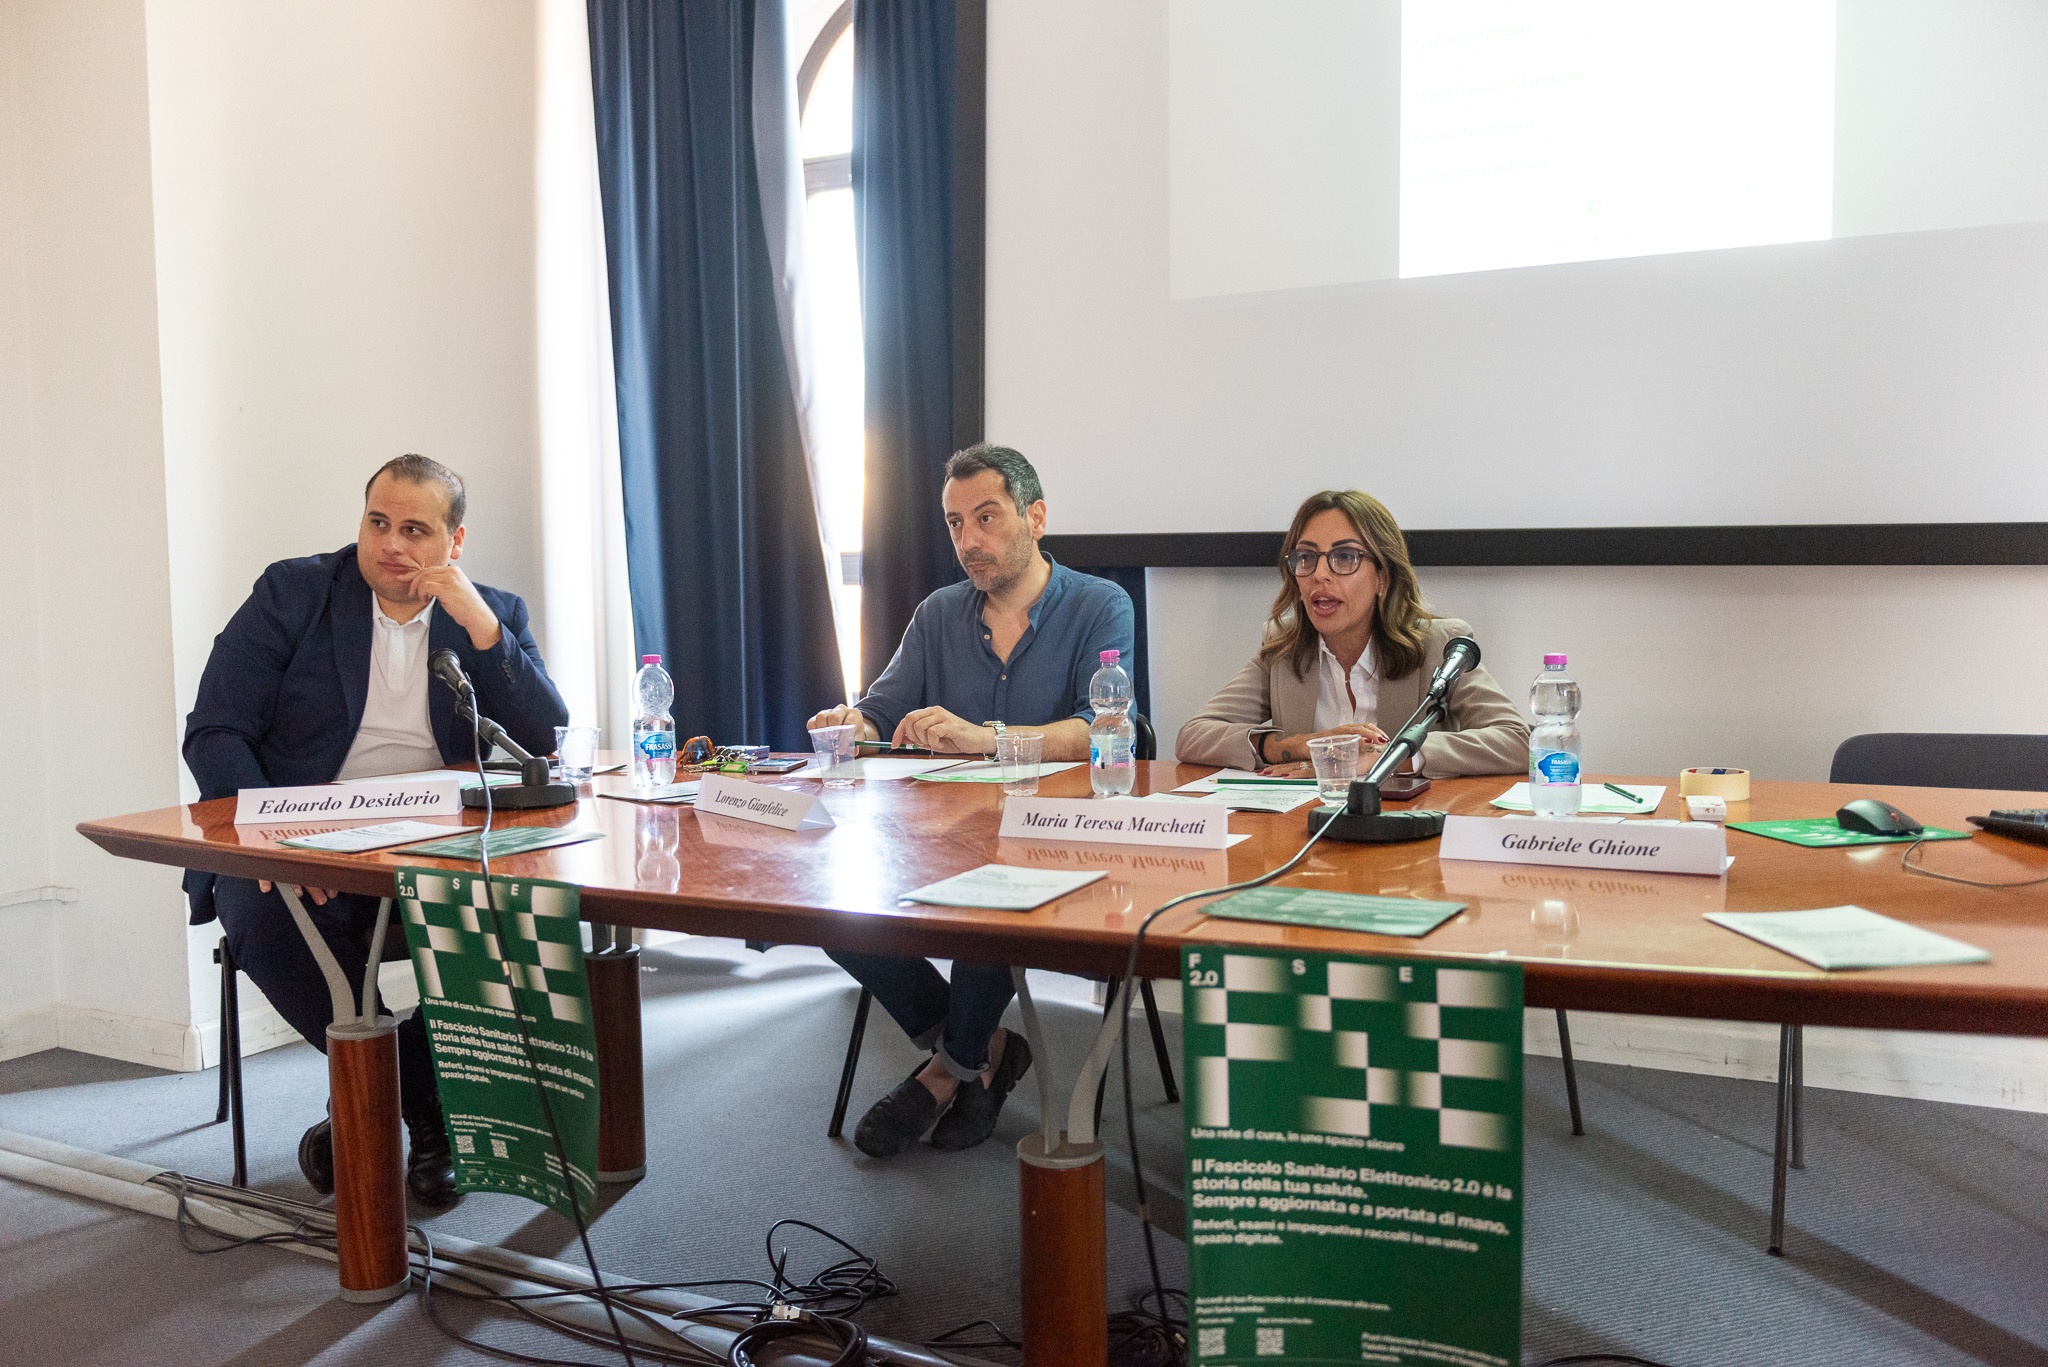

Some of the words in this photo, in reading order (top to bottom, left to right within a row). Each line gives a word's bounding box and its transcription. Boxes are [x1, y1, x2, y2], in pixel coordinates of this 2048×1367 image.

[258, 797, 342, 814] Edoardo
[348, 790, 440, 809] Desiderio
[716, 790, 747, 808] Lorenzo
[748, 798, 789, 818] Gianfelice
[1022, 812, 1068, 828] Maria
[1074, 814, 1124, 831] Teresa
[1128, 816, 1206, 835] Marchetti
[1501, 834, 1582, 853] Gabriele
[1588, 838, 1660, 857] Ghione
[398, 872, 404, 883] F
[452, 878, 460, 890] S
[510, 884, 519, 896] E
[400, 886, 414, 897] 2.0
[1188, 954, 1200, 968] F
[1292, 960, 1306, 974] S
[1400, 966, 1412, 982] E
[1190, 970, 1218, 986] 2.0
[430, 1019, 436, 1028] Il
[437, 1020, 478, 1034] Fascicolo
[479, 1026, 517, 1042] Sanitario
[518, 1034, 566, 1052] Ettronico
[566, 1044, 580, 1056] 2.0
[586, 1050, 594, 1062] la
[432, 1032, 460, 1042] storia
[460, 1035, 481, 1046] della
[482, 1039, 496, 1050] tua
[497, 1043, 526, 1056] salute.
[434, 1043, 472, 1056] Sempre
[472, 1050, 518, 1065] aggiornata
[526, 1060, 532, 1068] a
[534, 1062, 563, 1076] ortata
[564, 1068, 572, 1078] di
[573, 1072, 596, 1088] mano.
[438, 1060, 464, 1070] Referti,
[1191, 1128, 1216, 1139] Una
[1192, 1158, 1202, 1173] Il
[1204, 1158, 1282, 1175] Fascicolo
[1284, 1161, 1358, 1181] Sanitario
[1359, 1167, 1450, 1192] Elettronico
[1452, 1176, 1480, 1196] 2.0
[1496, 1184, 1512, 1200] la
[1192, 1176, 1240, 1190] storia
[1241, 1176, 1282, 1192] della
[1283, 1179, 1310, 1194] tua
[1313, 1182, 1368, 1199] salute.
[1192, 1193, 1257, 1210] Sempre
[1258, 1196, 1347, 1214] aggiornata
[1348, 1202, 1360, 1215] e
[1362, 1204, 1374, 1217] a
[1375, 1206, 1437, 1224] portata
[1438, 1211, 1456, 1226] di
[1456, 1216, 1510, 1236] mano.
